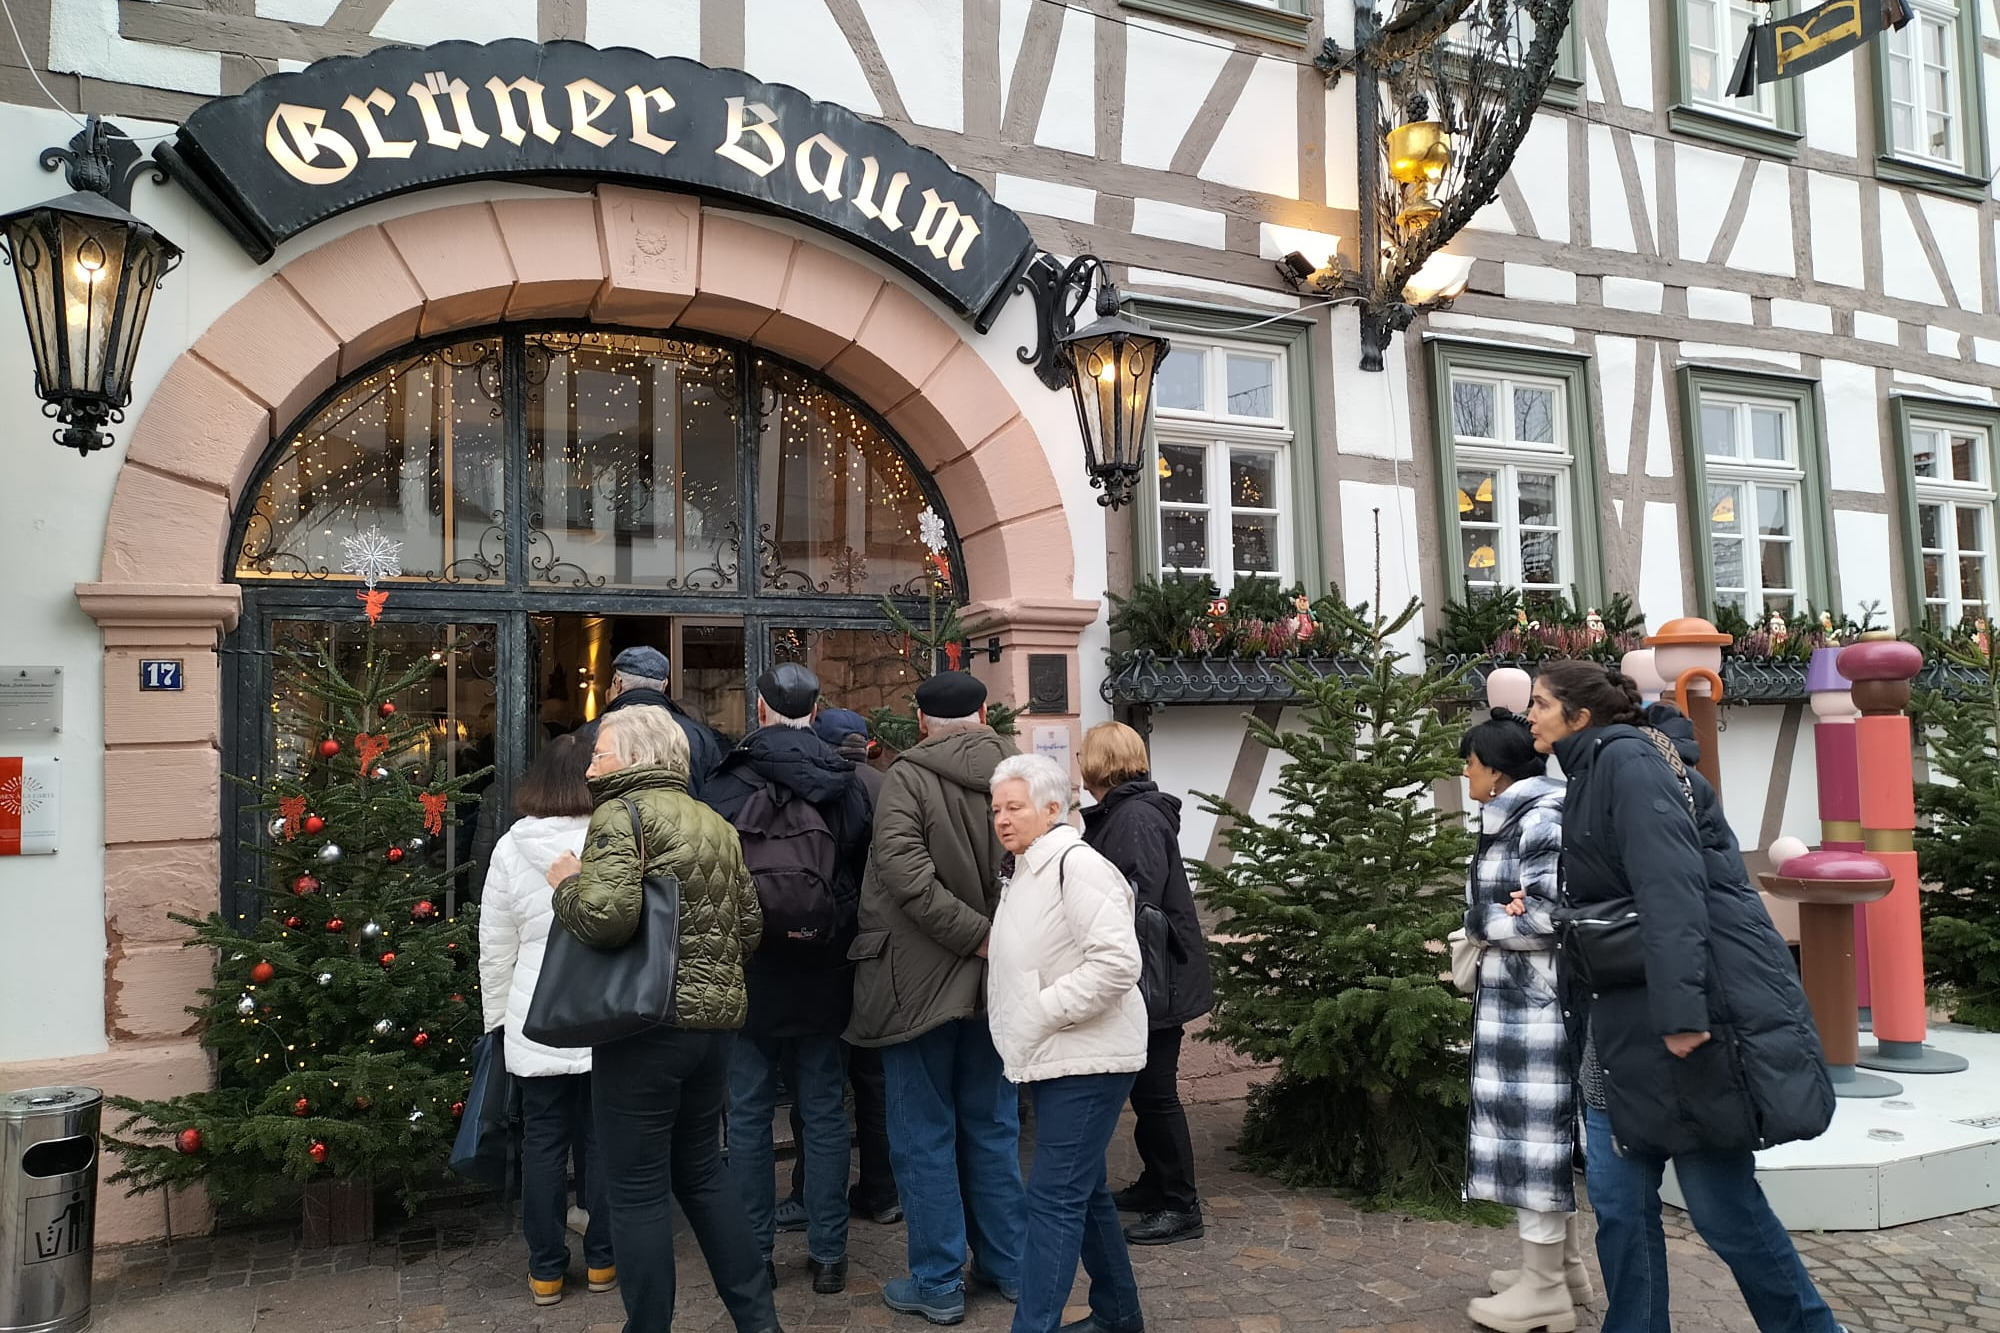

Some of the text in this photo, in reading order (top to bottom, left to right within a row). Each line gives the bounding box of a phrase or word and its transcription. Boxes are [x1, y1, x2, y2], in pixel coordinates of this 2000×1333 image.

[265, 70, 982, 272] Grüner Baum
[147, 663, 176, 686] 17
